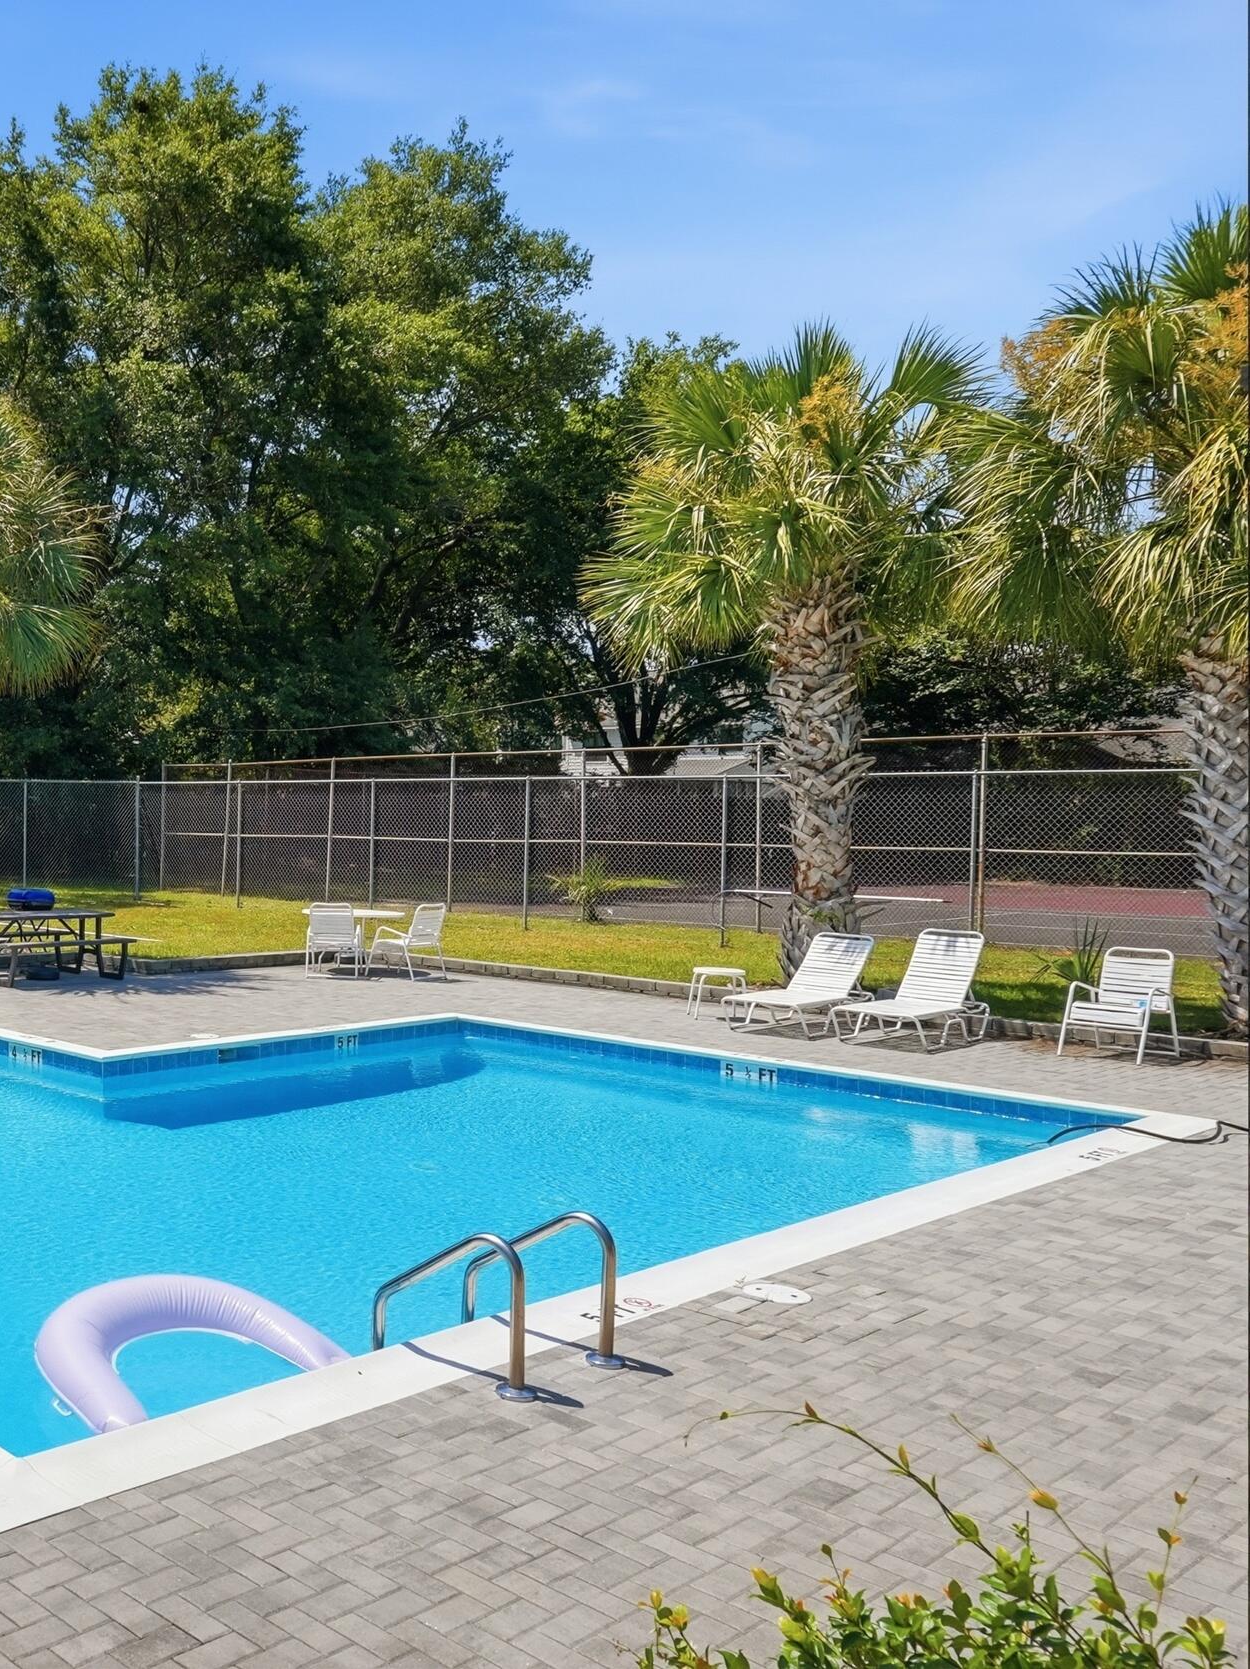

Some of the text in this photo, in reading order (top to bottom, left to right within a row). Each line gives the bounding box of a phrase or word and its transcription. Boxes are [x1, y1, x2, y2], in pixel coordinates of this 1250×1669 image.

[337, 1034, 358, 1048] 5 FT
[11, 1045, 17, 1057] 4
[30, 1049, 42, 1065] FT
[725, 1063, 734, 1077] 5
[758, 1067, 776, 1082] FT
